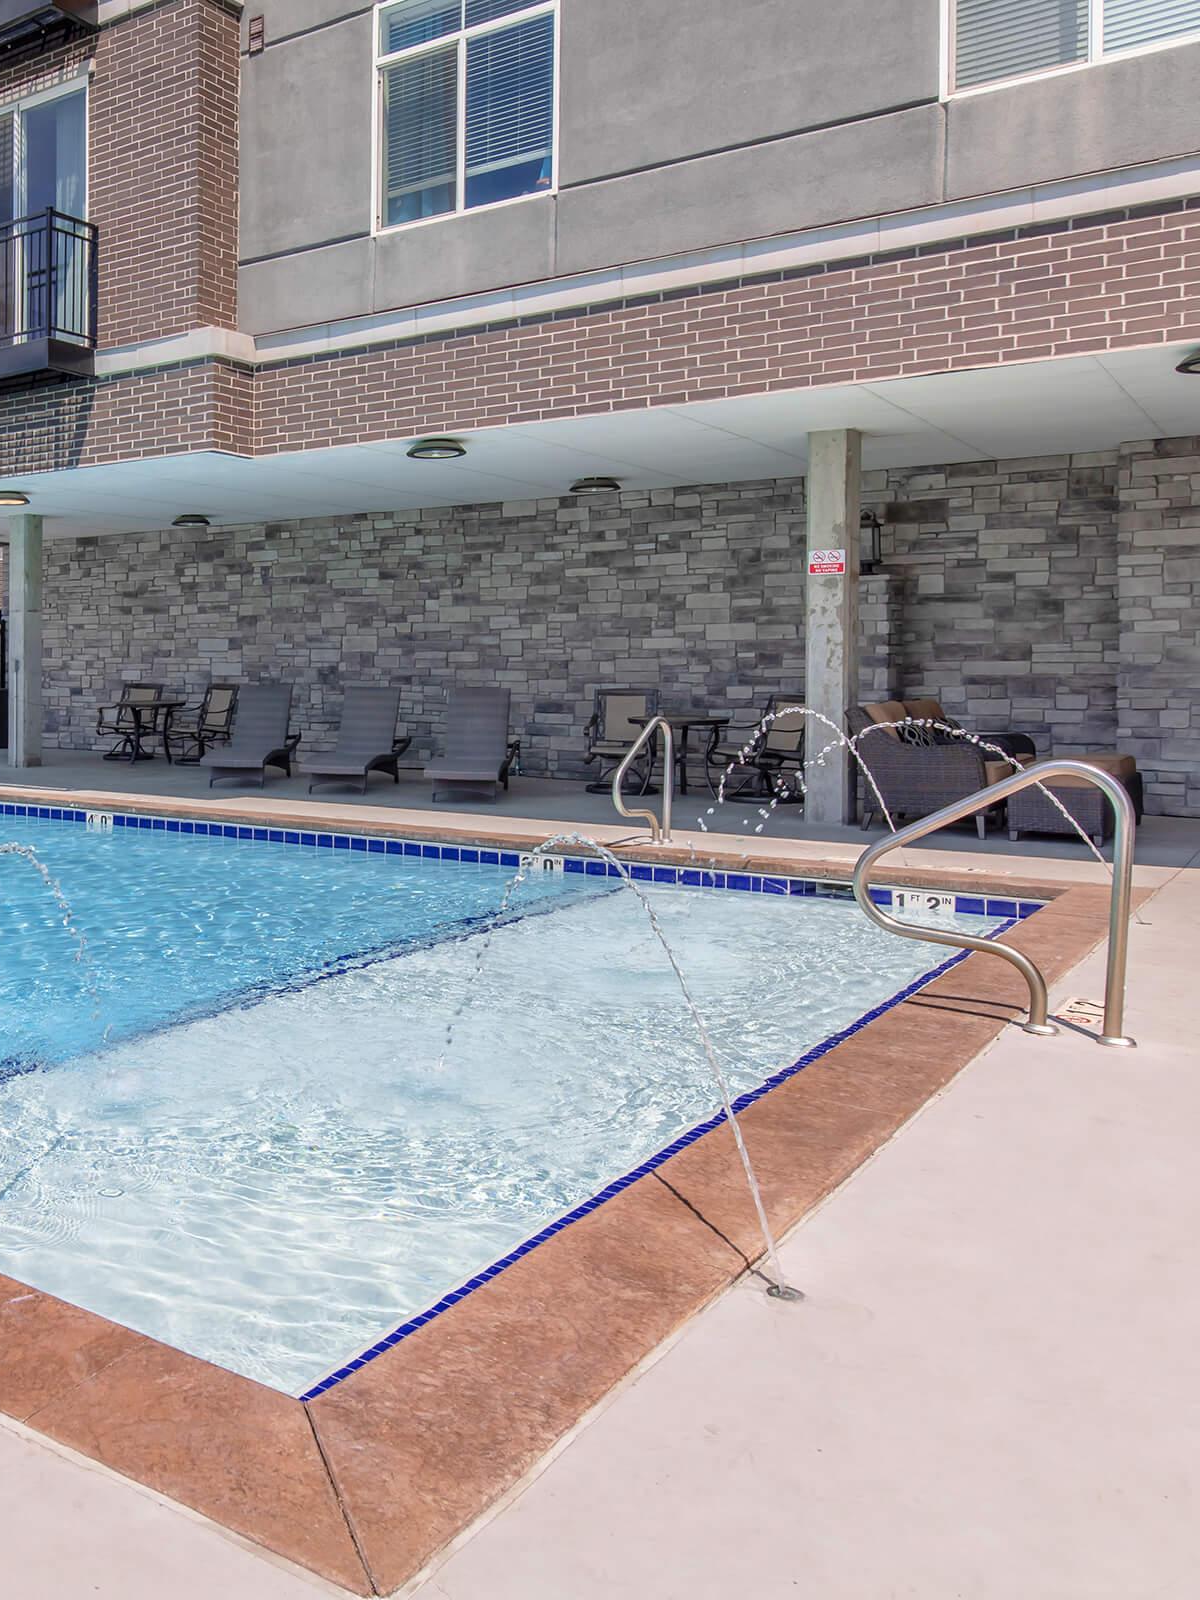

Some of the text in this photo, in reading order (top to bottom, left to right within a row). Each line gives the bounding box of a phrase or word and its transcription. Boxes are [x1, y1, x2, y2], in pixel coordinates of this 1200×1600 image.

[896, 893, 952, 910] 1 FT 2 IN
